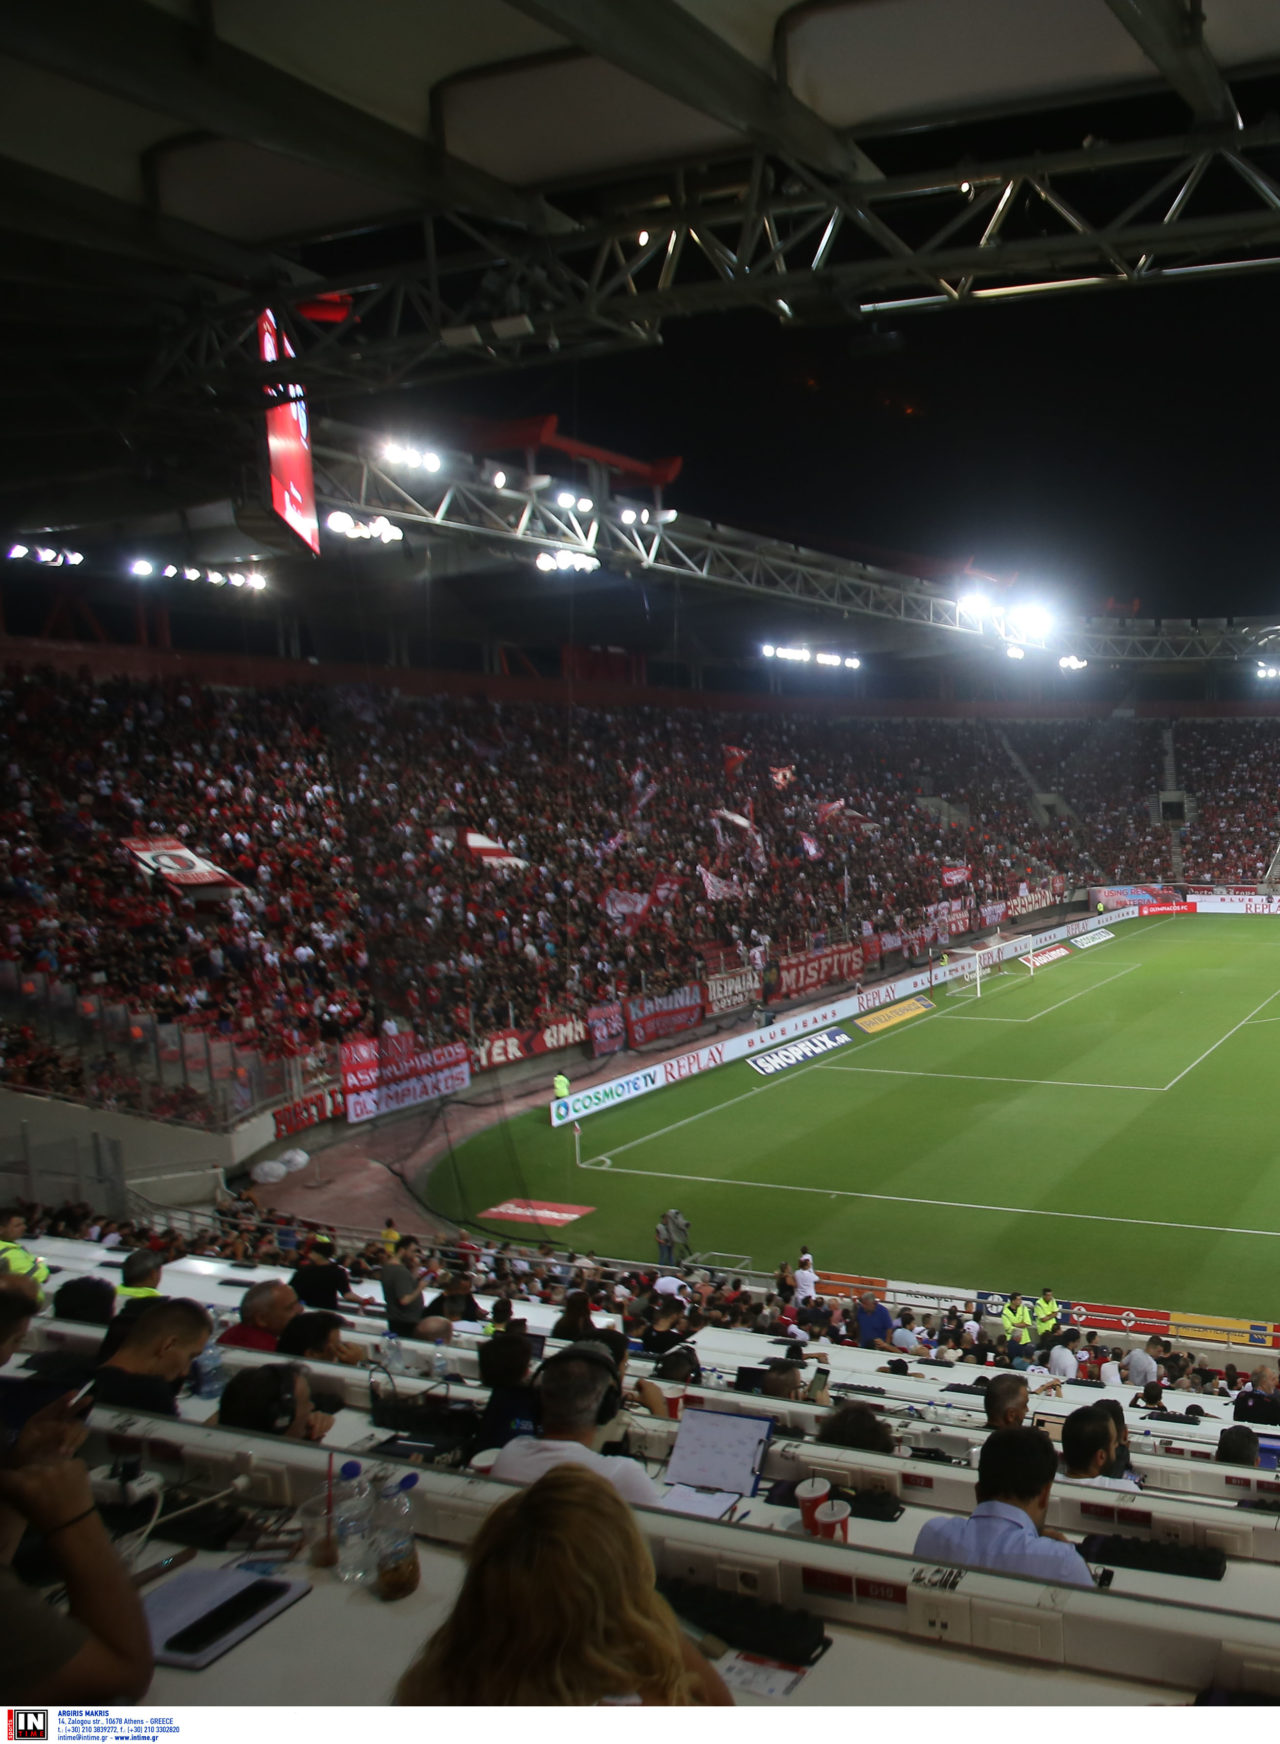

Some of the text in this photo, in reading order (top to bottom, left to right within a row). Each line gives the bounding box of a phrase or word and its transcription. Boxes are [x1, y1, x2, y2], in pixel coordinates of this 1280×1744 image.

[780, 949, 864, 993] MISFITS
[857, 984, 897, 1012] REPLAY
[747, 1010, 837, 1048] BLUE JEANS
[664, 1043, 727, 1084] REPLAY
[571, 1070, 658, 1113] COSMOTE TV
